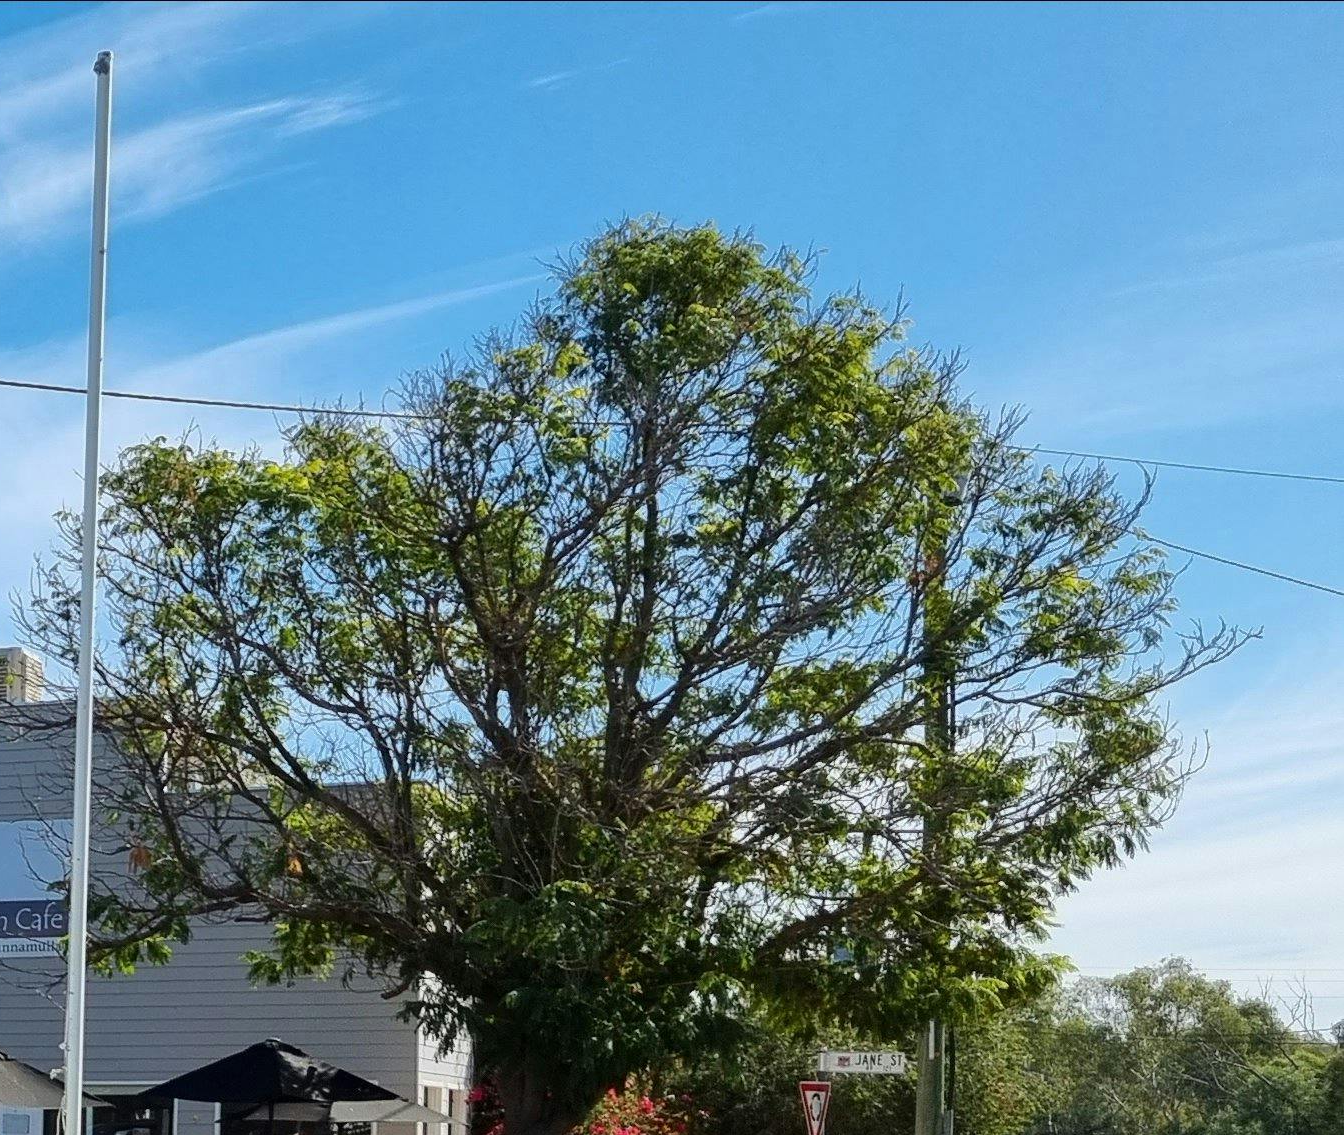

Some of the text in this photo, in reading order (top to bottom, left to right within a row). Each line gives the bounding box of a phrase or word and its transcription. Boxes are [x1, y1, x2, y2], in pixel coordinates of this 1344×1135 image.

[16, 901, 63, 932] Cafe
[855, 1054, 903, 1067] JANE ST
